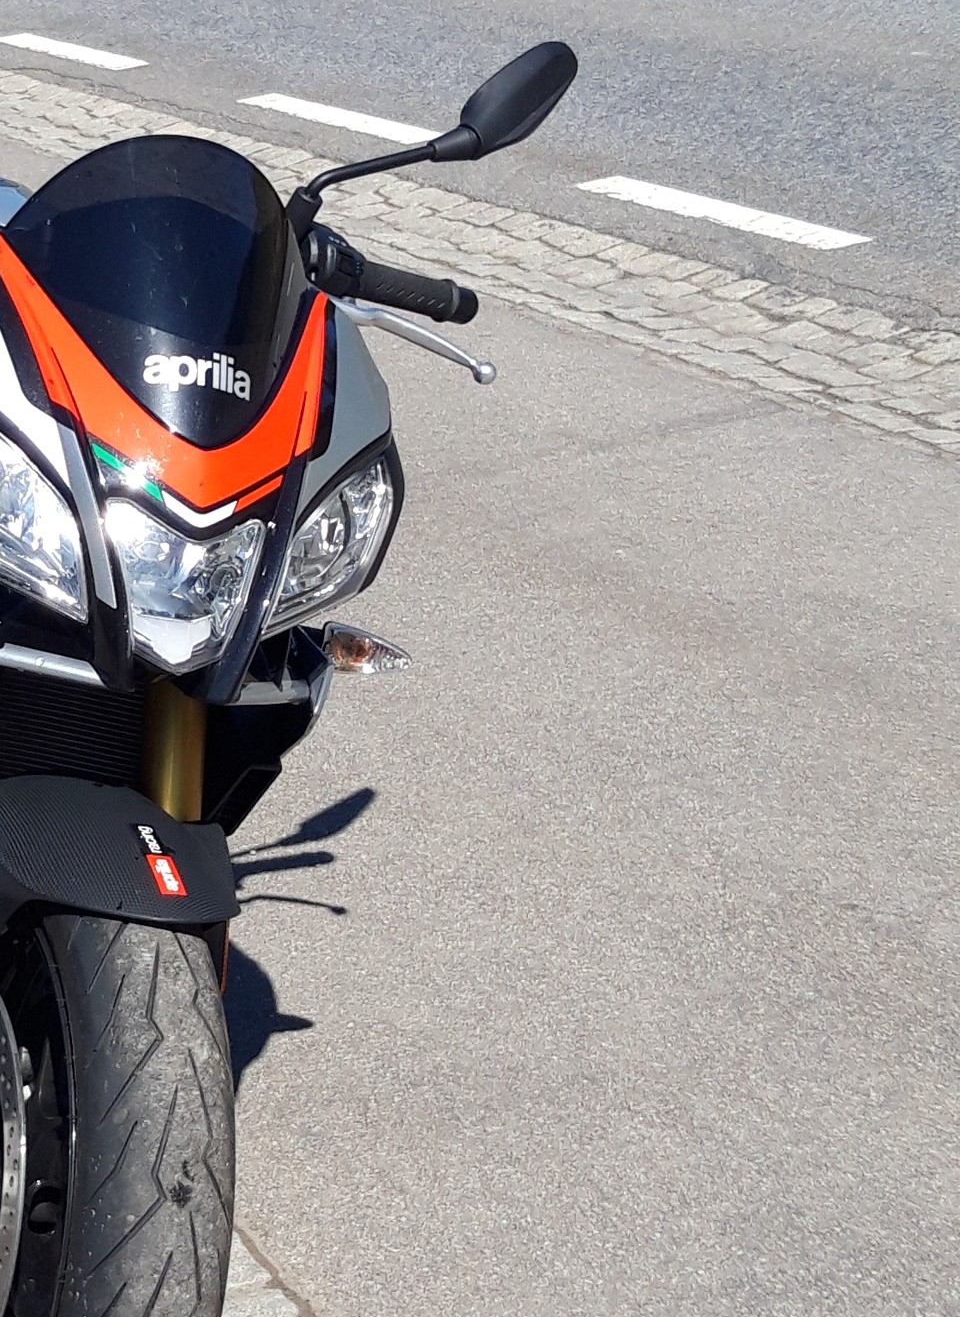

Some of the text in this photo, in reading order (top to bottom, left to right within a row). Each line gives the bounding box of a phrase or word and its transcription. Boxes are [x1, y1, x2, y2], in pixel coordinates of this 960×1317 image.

[143, 352, 251, 402] aprilia
[137, 825, 180, 892] aprilia racing
